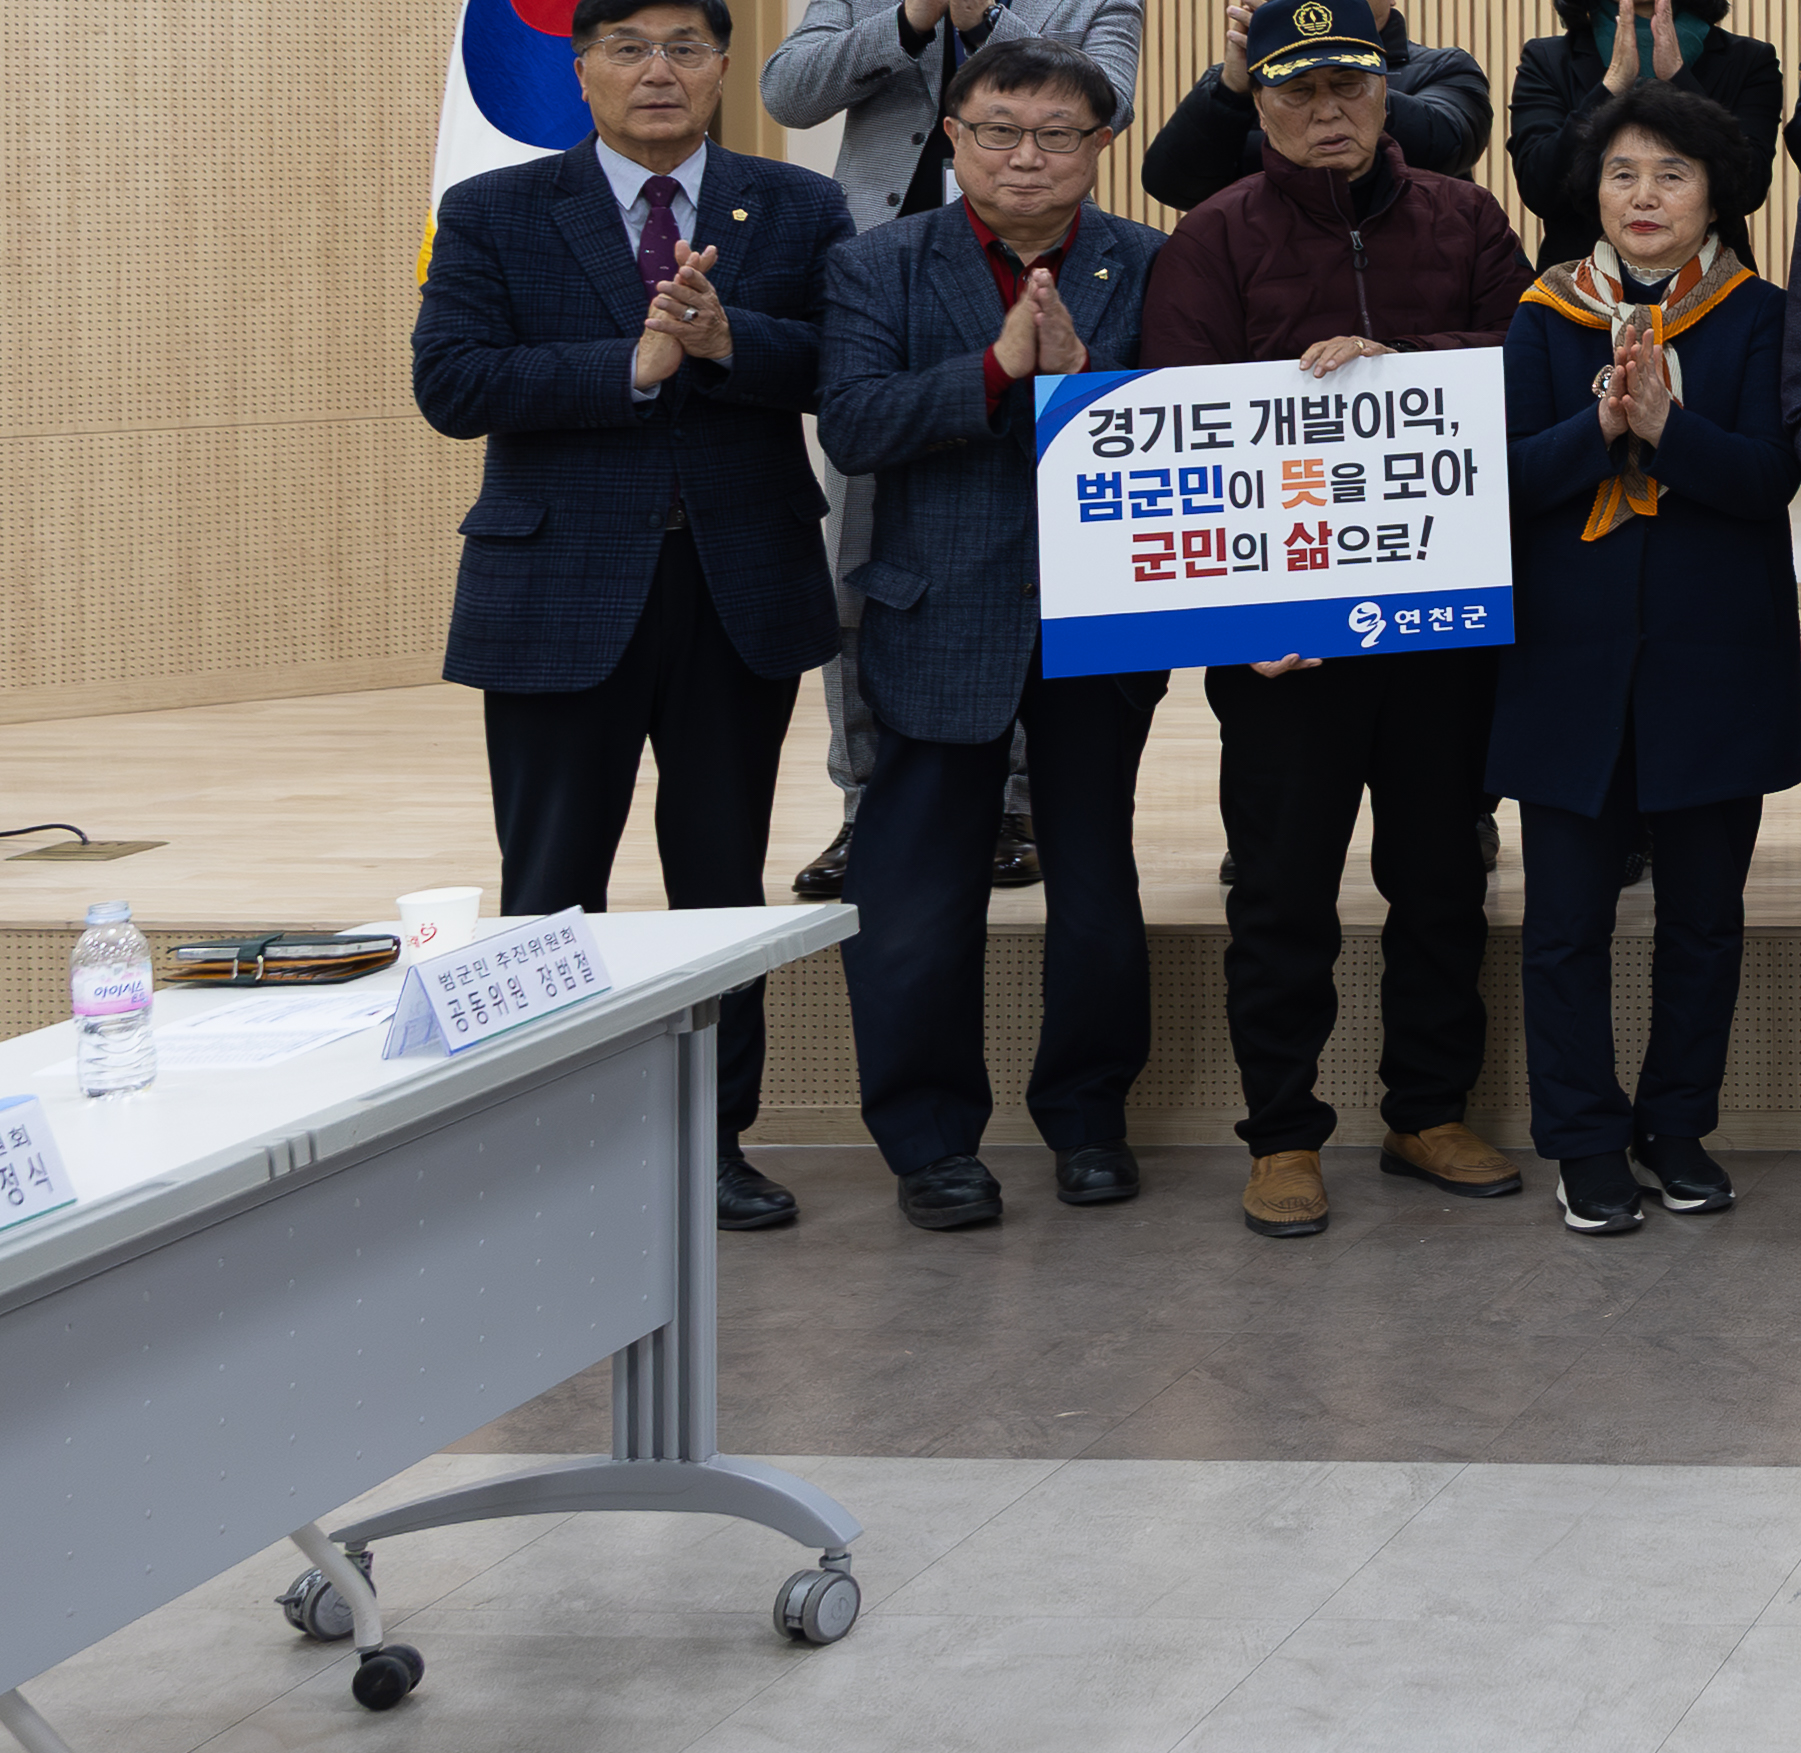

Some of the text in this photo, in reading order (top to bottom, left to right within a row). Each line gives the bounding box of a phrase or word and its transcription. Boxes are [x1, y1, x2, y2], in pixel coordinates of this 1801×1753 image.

[1088, 387, 1460, 458] 경기도 개발이익,
[1077, 448, 1478, 523] 범군민이 뜻을 모아
[1131, 515, 1434, 583] 군민의 삶으로!
[1395, 605, 1488, 635] 연천군
[438, 925, 578, 993] 범군민 추진위원회
[447, 974, 529, 1033] 공동위원
[536, 949, 596, 998] 장범철
[0, 1123, 32, 1156] 회
